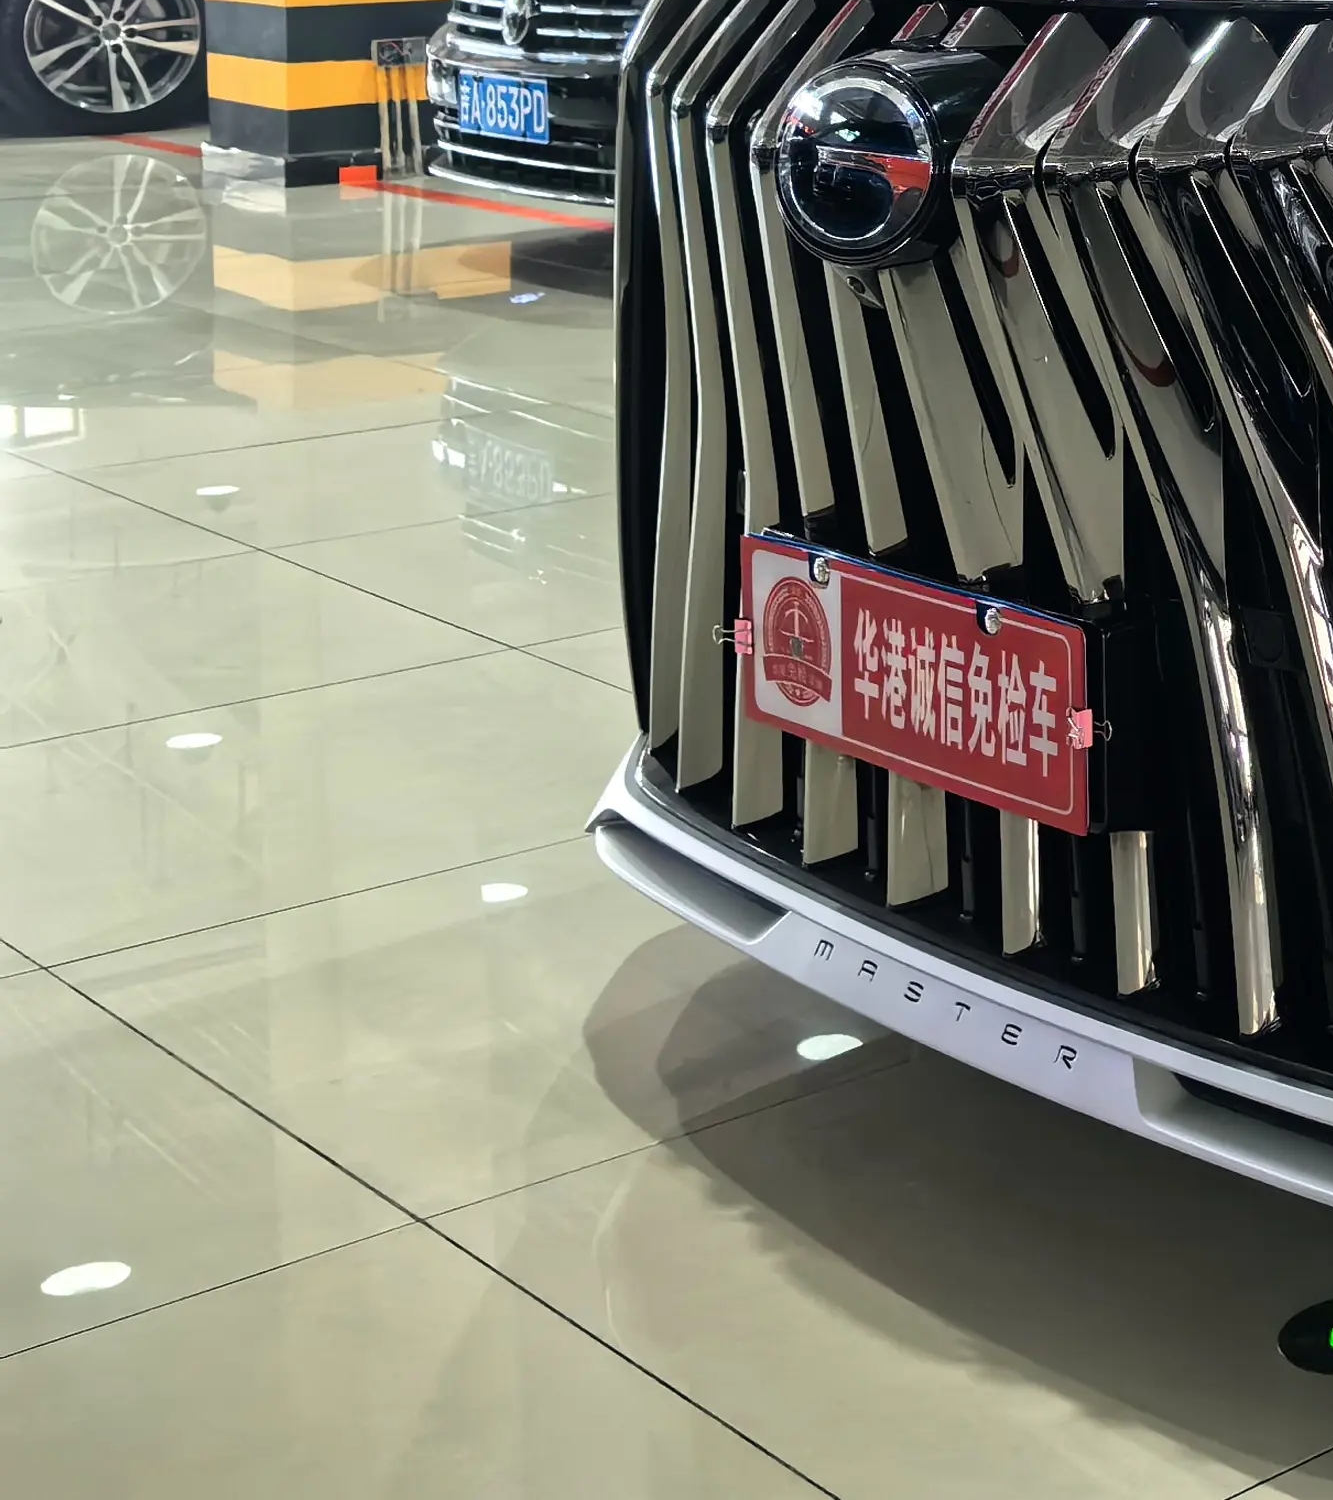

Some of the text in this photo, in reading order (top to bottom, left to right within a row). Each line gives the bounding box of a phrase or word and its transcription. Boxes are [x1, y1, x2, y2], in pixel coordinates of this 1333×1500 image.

[854, 607, 1059, 778] 华港诚信免检车
[813, 938, 1078, 1071] MASTER
